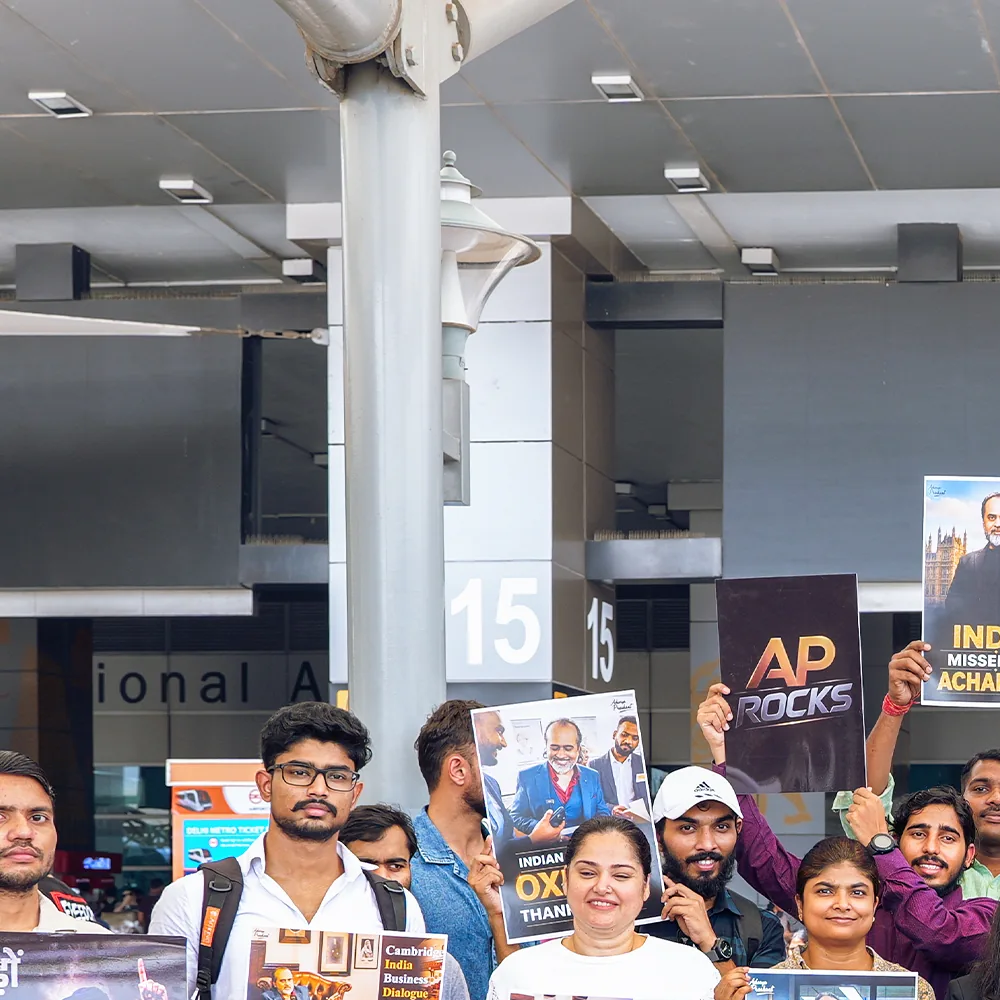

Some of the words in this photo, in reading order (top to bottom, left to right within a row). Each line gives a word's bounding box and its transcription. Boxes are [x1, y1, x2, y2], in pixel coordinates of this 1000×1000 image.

[450, 577, 541, 665] 15
[587, 597, 614, 683] 15
[745, 635, 836, 689] AP
[96, 660, 249, 704] ional
[289, 660, 323, 702] A
[735, 683, 853, 728] ROCKS
[210, 826, 237, 835] METRO
[237, 826, 265, 835] TICKET
[518, 852, 565, 868] INDIAN
[383, 959, 413, 970] India
[383, 973, 429, 985] Business
[382, 987, 429, 1000] Dialogue
